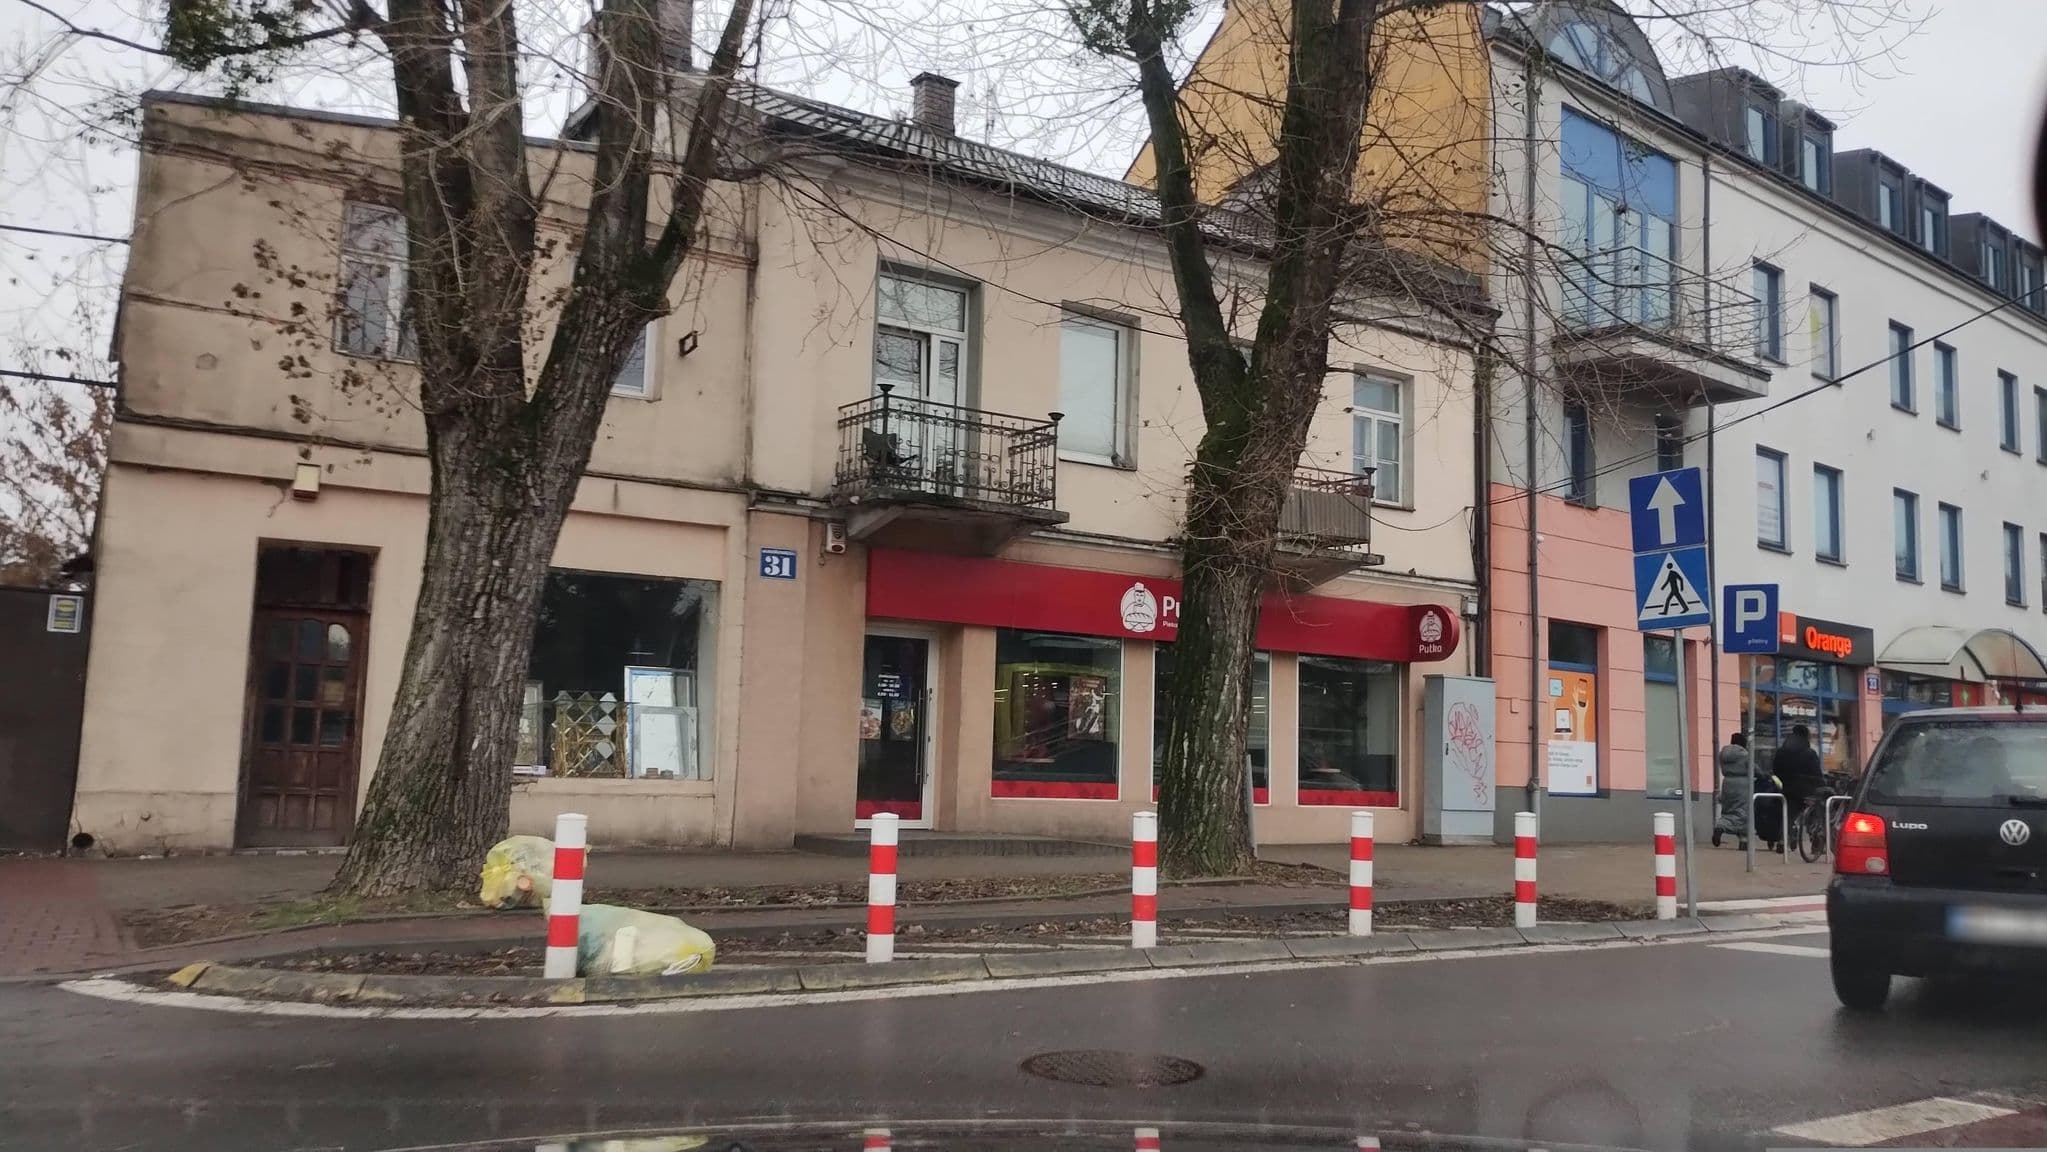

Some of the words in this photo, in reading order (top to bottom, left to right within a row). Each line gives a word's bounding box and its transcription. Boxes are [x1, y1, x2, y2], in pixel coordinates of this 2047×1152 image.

[764, 555, 792, 577] 31
[1735, 590, 1767, 633] P
[1419, 644, 1442, 654] Putka
[1805, 626, 1852, 658] Orange
[1892, 821, 1928, 830] Lupo
